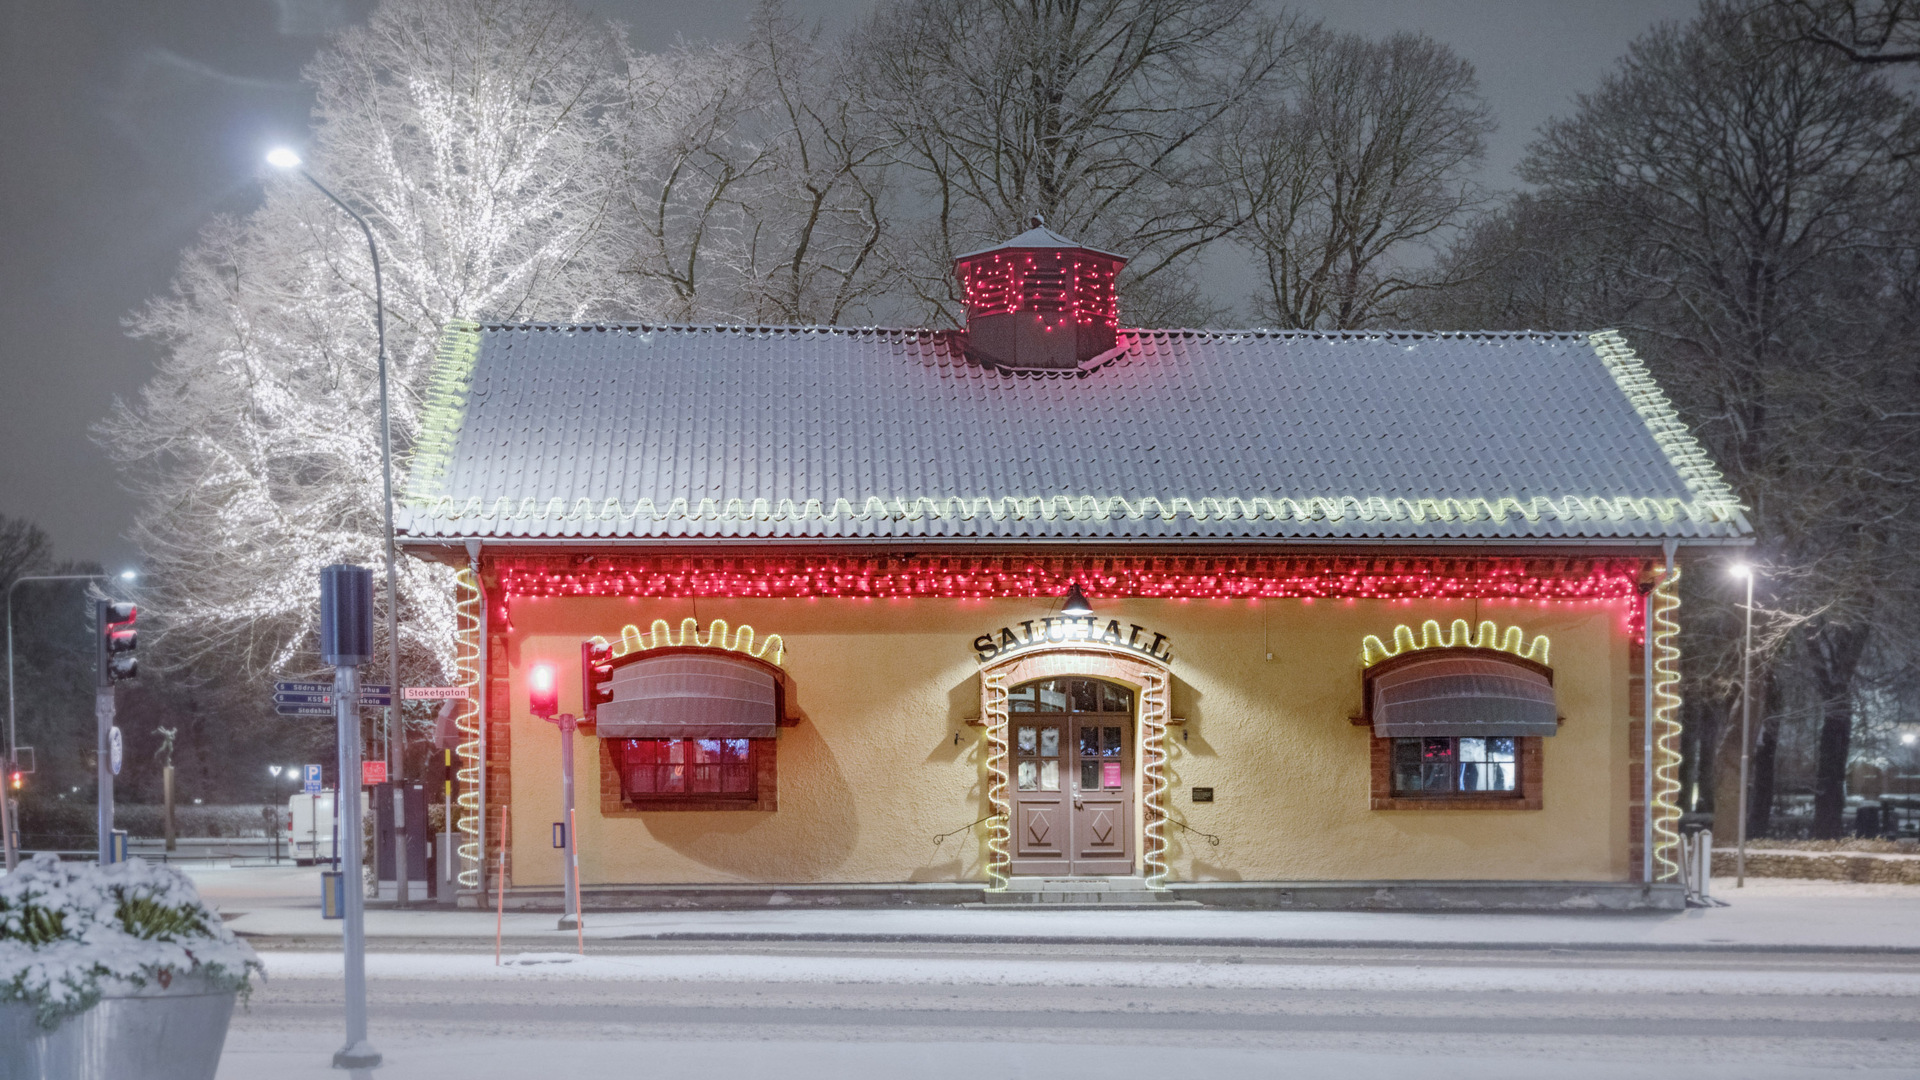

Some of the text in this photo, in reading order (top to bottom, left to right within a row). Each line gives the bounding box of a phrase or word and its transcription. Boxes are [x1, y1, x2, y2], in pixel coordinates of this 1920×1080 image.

[973, 616, 1170, 662] SALUHALL
[293, 683, 315, 691] Södra
[409, 689, 466, 698] Staketgatan
[309, 766, 319, 780] P
